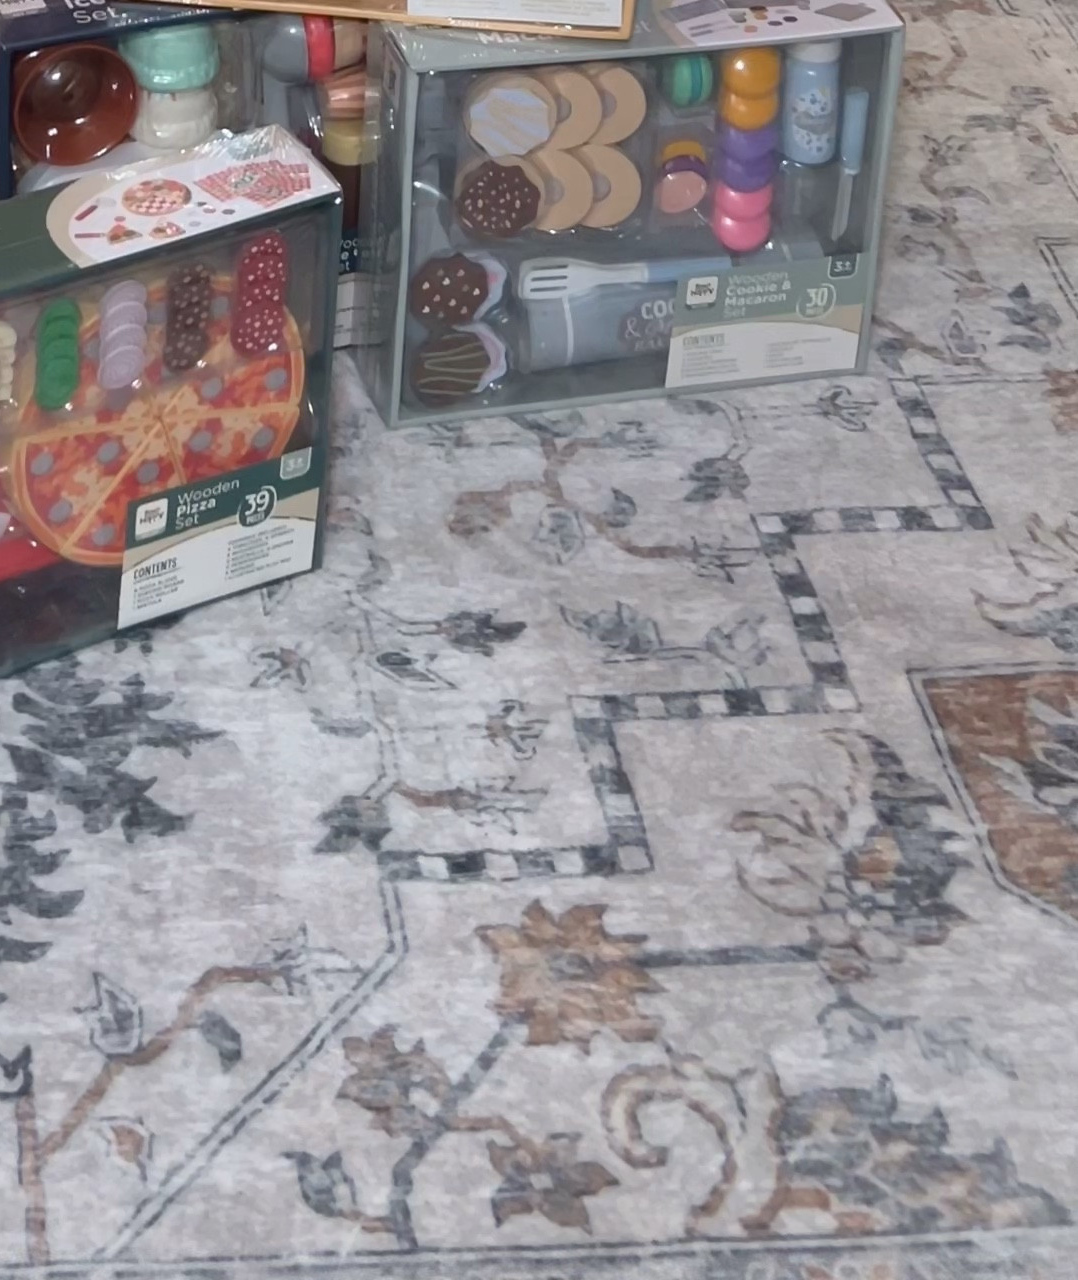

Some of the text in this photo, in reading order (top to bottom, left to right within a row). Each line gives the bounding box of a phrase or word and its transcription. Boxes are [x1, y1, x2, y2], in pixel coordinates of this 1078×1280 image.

[728, 271, 789, 286] Wooden
[726, 280, 791, 297] Cookie &
[724, 292, 787, 306] Macaron
[723, 306, 746, 318] Set
[178, 479, 240, 505] Wooden
[176, 498, 216, 518] Pizza
[244, 490, 270, 516] 39
[175, 514, 199, 531] Set
[133, 557, 178, 579] CONTENTS
